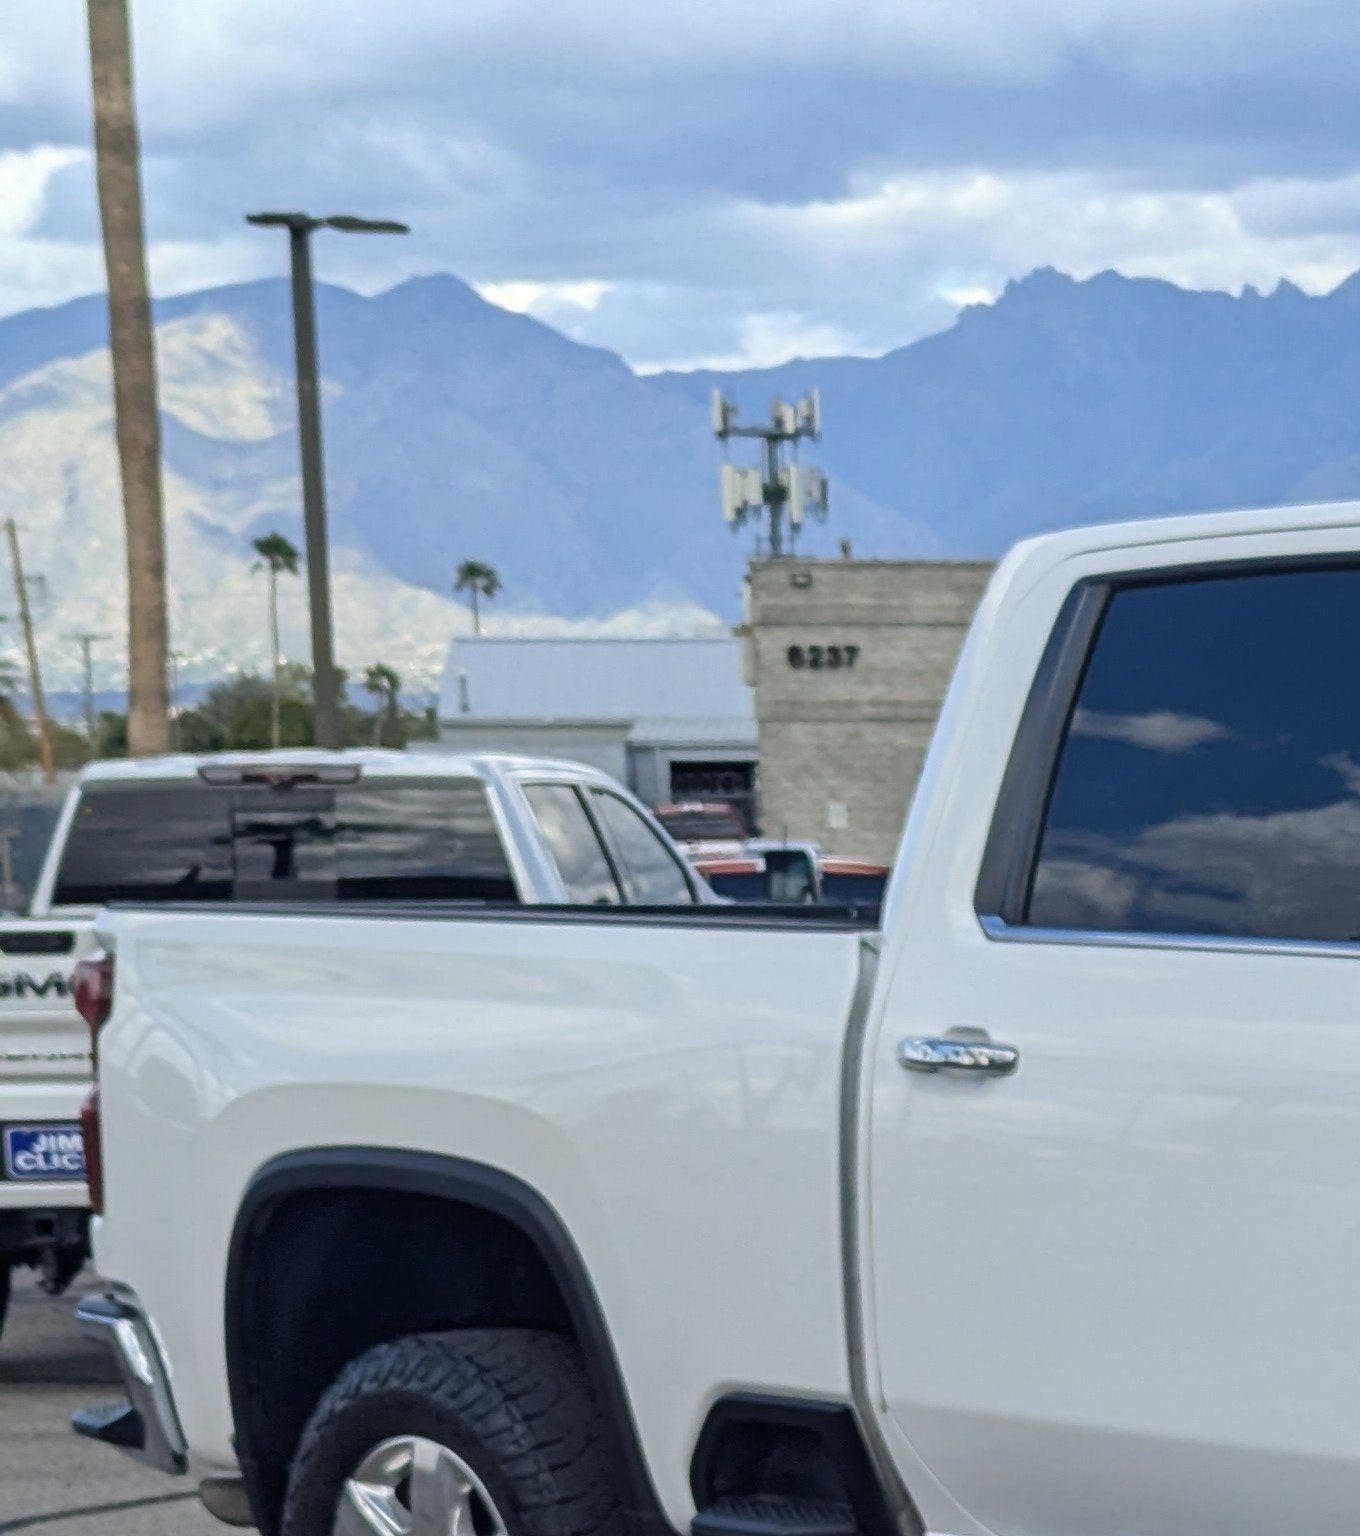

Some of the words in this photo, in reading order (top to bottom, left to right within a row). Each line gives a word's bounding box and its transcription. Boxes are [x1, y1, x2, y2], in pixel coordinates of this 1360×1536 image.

[786, 644, 860, 670] 6237
[32, 1133, 84, 1153] JIM
[14, 1150, 86, 1171] CLIC
